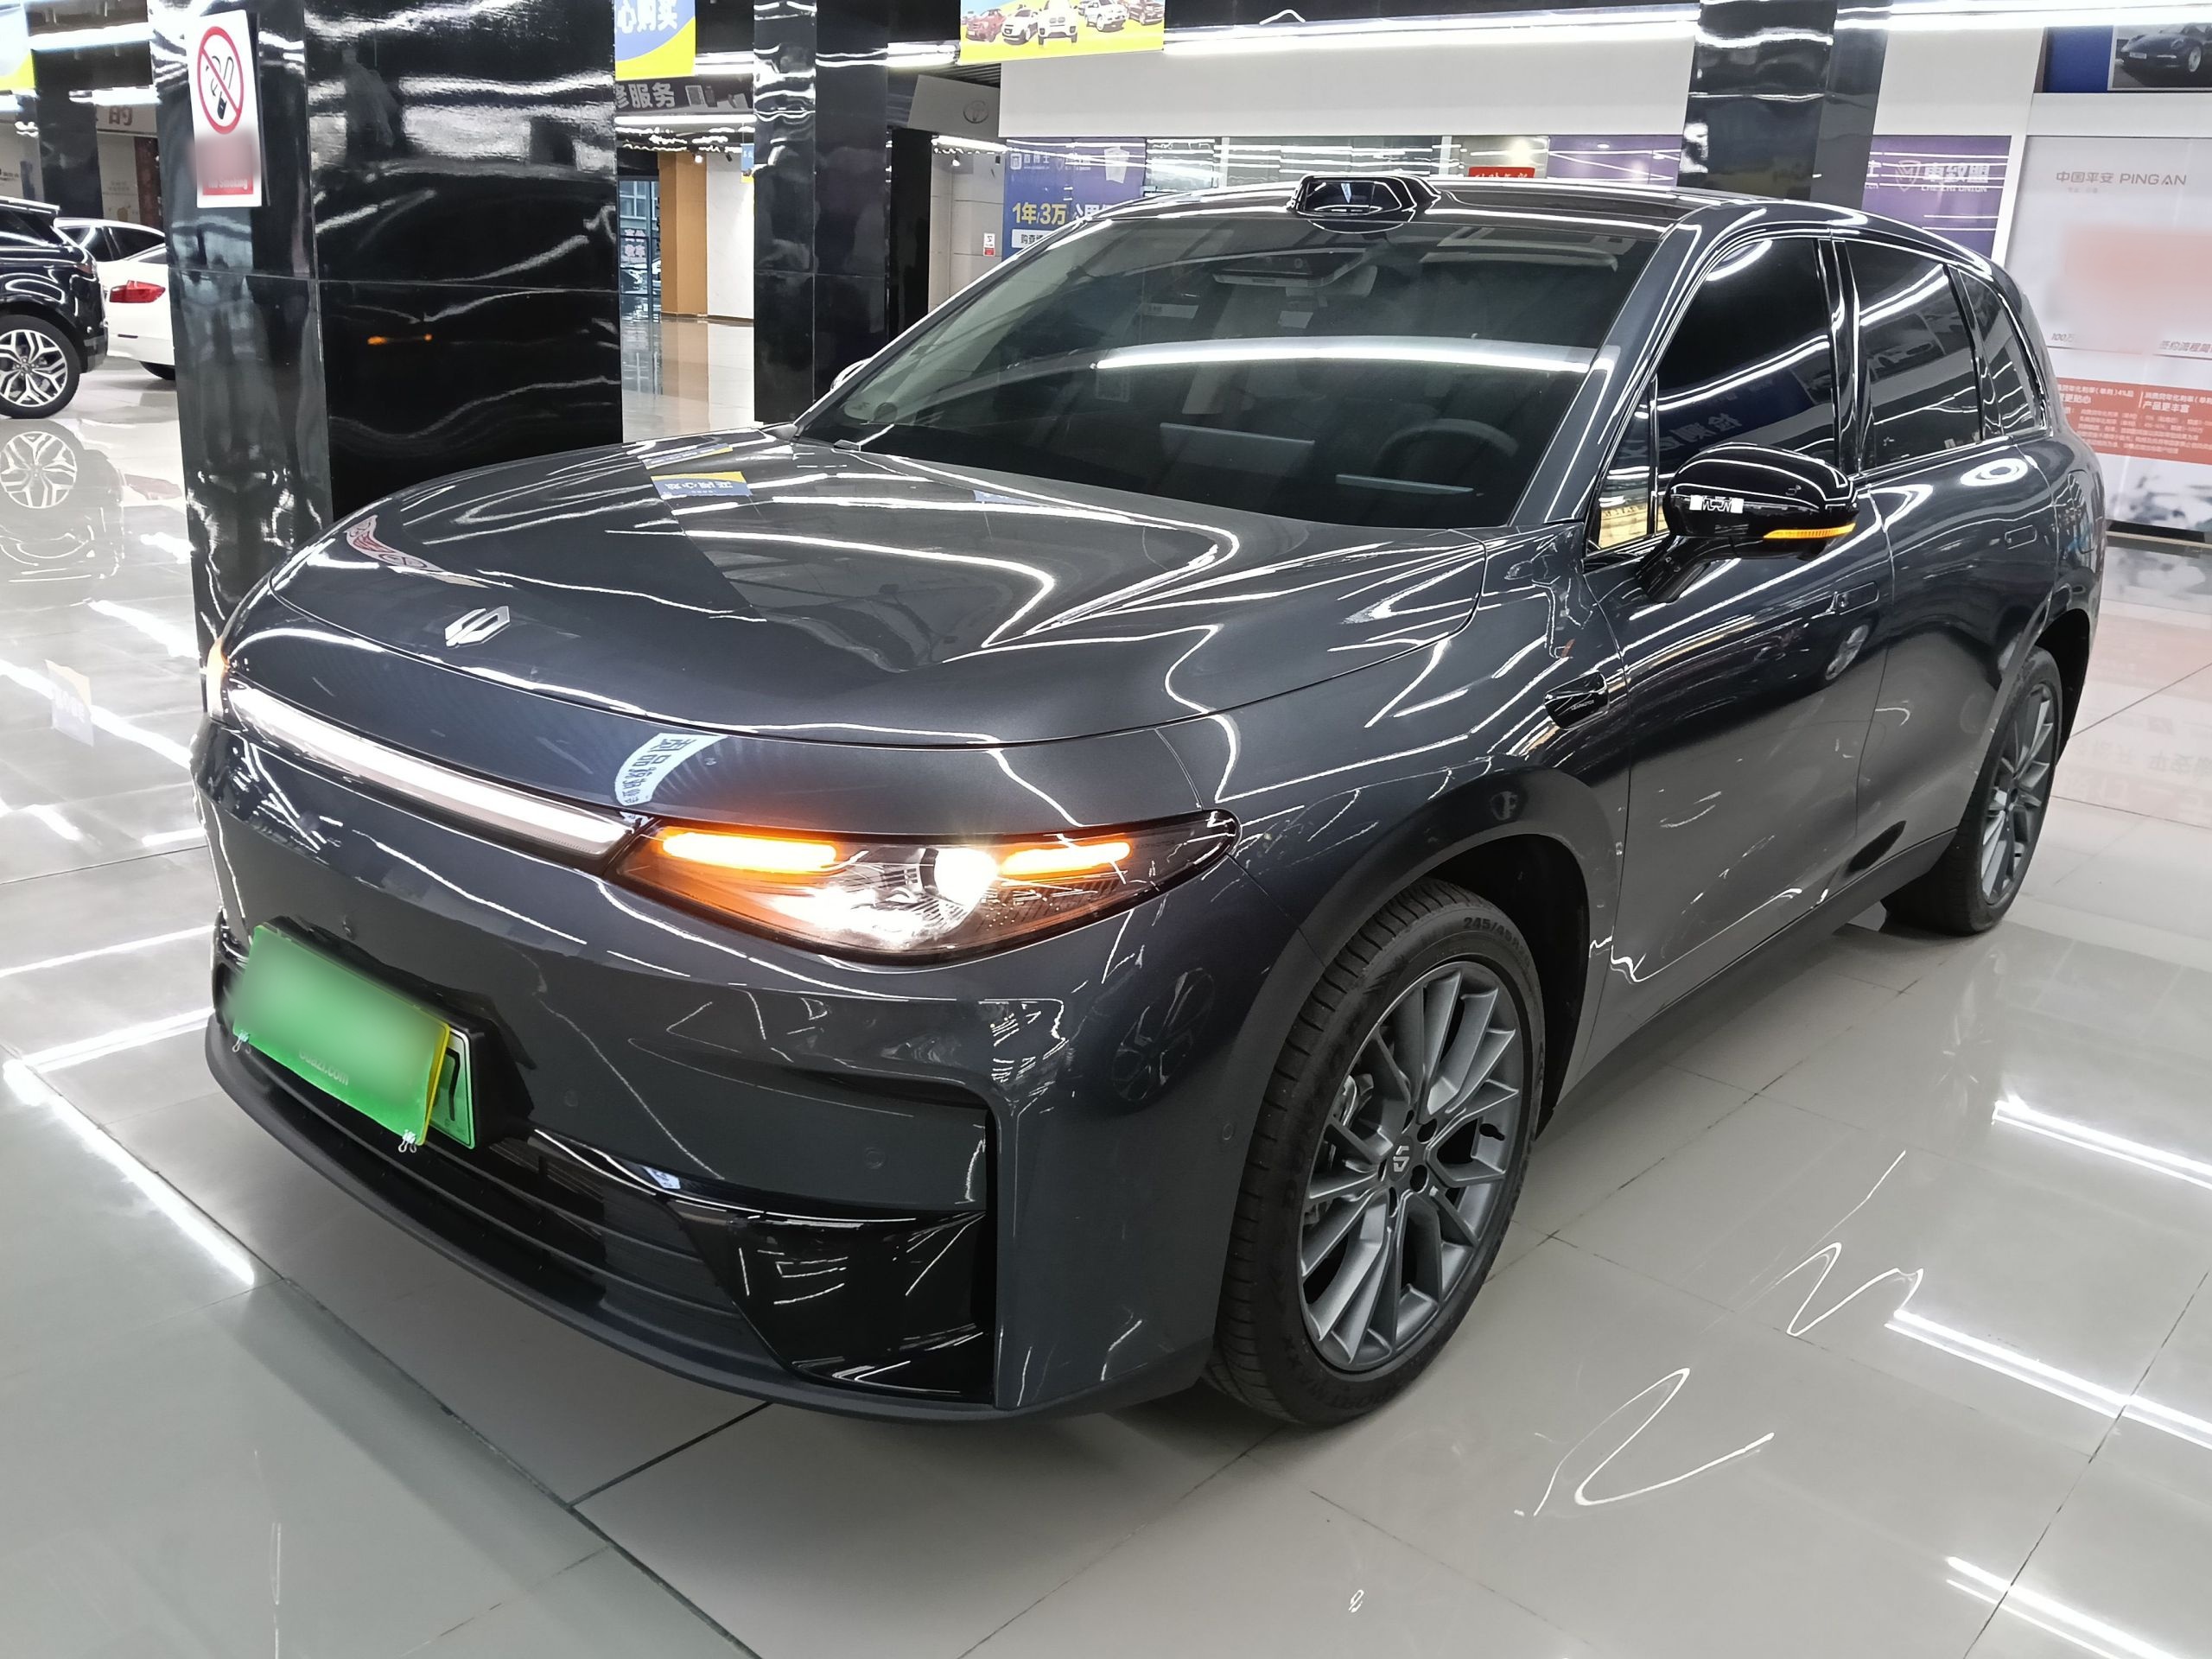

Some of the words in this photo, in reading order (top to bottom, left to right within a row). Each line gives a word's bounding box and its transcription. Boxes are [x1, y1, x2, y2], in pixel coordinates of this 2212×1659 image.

[614, 0, 678, 34] 心购买
[109, 106, 133, 126] 的
[2056, 171, 2114, 184] 中国平安
